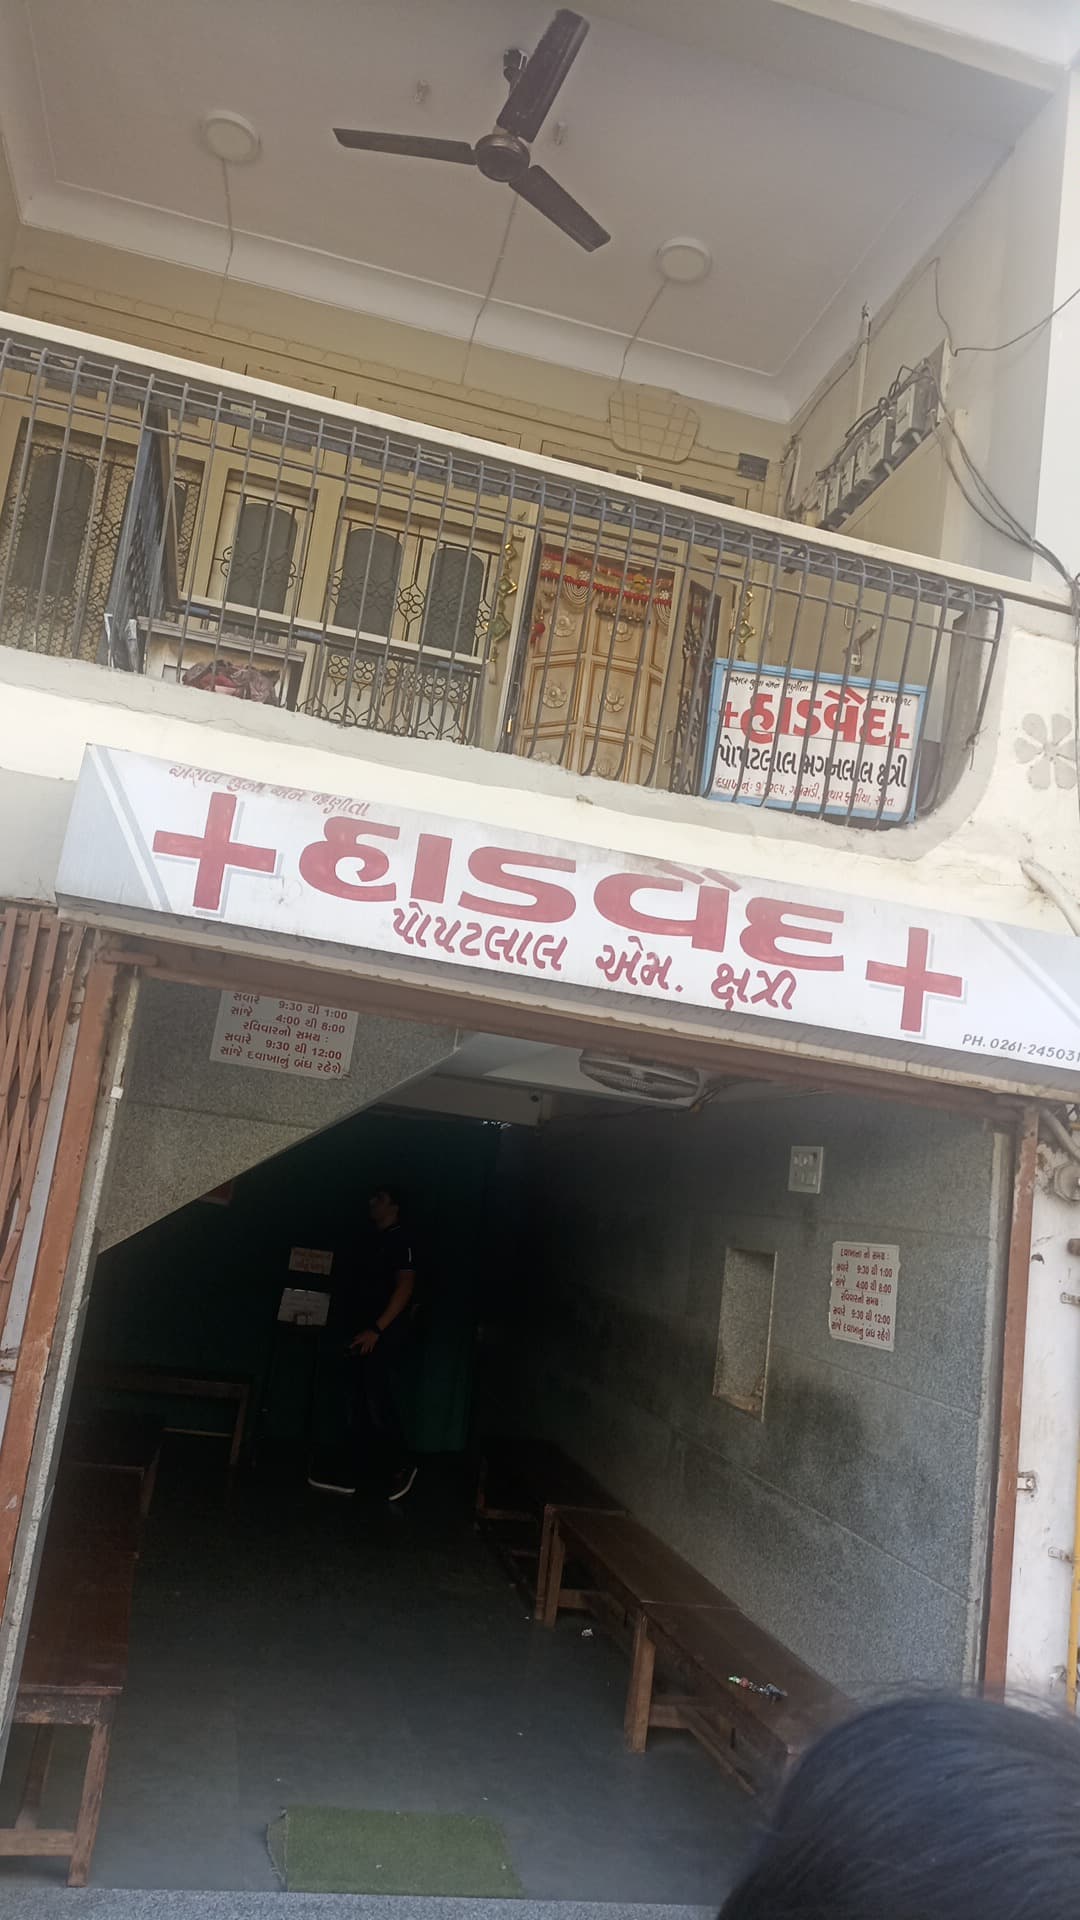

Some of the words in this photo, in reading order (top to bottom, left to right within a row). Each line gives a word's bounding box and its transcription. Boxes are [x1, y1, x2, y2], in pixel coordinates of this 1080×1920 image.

[717, 735, 797, 775] પોપટલાલ
[299, 816, 844, 972] હાડવૈદ
[393, 902, 568, 971] પોપટલાલ
[595, 935, 684, 992] એમ.
[278, 1001, 303, 1012] 9:30
[325, 1008, 348, 1020] 1:00
[243, 1020, 291, 1037] રવિવારનો
[296, 1030, 320, 1042] સમય
[275, 1015, 300, 1025] 4:00
[321, 1024, 345, 1033] 8:00
[224, 1032, 251, 1044] સવારે
[266, 1040, 290, 1051] 9:30
[312, 1047, 342, 1060] 12:00
[962, 1033, 986, 1047] PH.
[248, 1050, 291, 1069] દવાખાનું
[857, 1265, 869, 1275] 9:30
[880, 1268, 892, 1278] 1:00
[856, 1281, 868, 1290] 4:00
[879, 1284, 891, 1293] 8:00
[874, 1313, 890, 1325] 12:00
